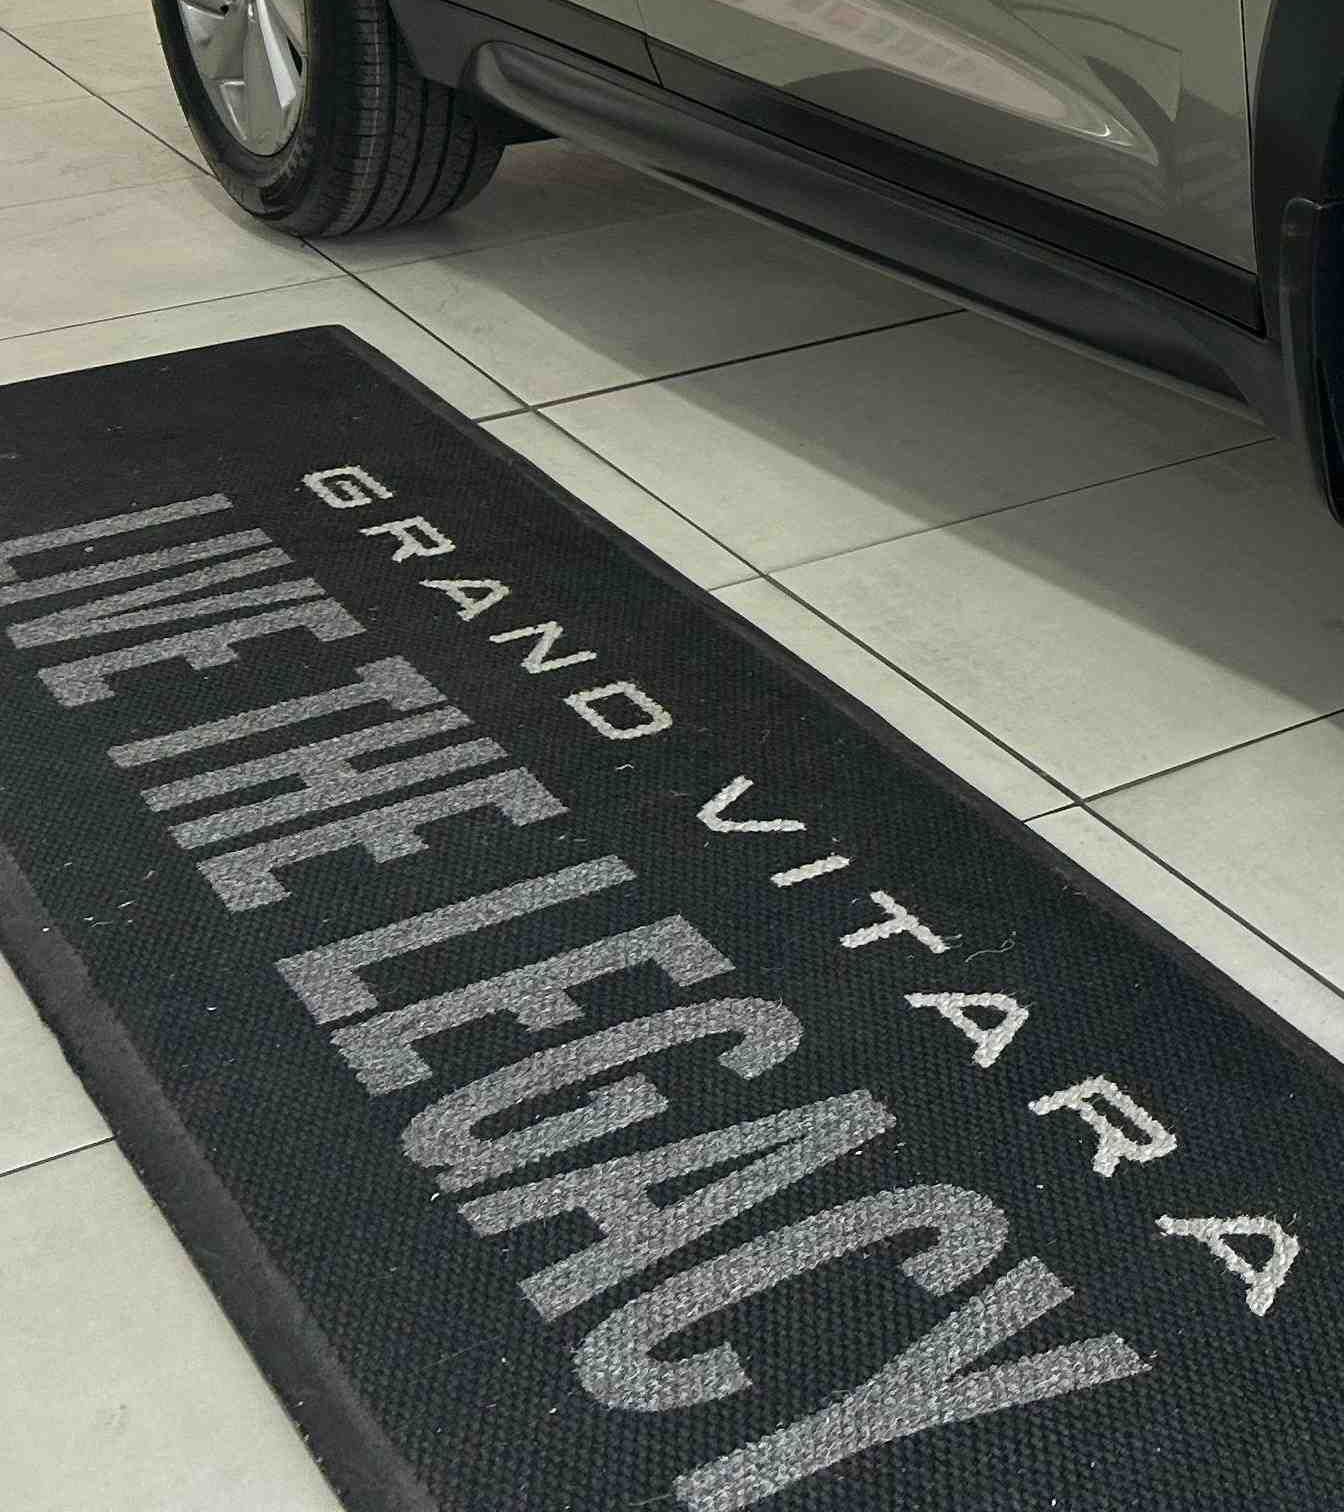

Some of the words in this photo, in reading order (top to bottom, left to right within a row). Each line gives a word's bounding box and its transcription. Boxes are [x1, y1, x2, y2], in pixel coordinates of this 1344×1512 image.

[0, 491, 366, 708] LIVE
[108, 654, 570, 914] THE
[302, 464, 674, 742] GRAND
[697, 775, 1302, 1318] VITARA
[276, 854, 1156, 1512] LEGACY
